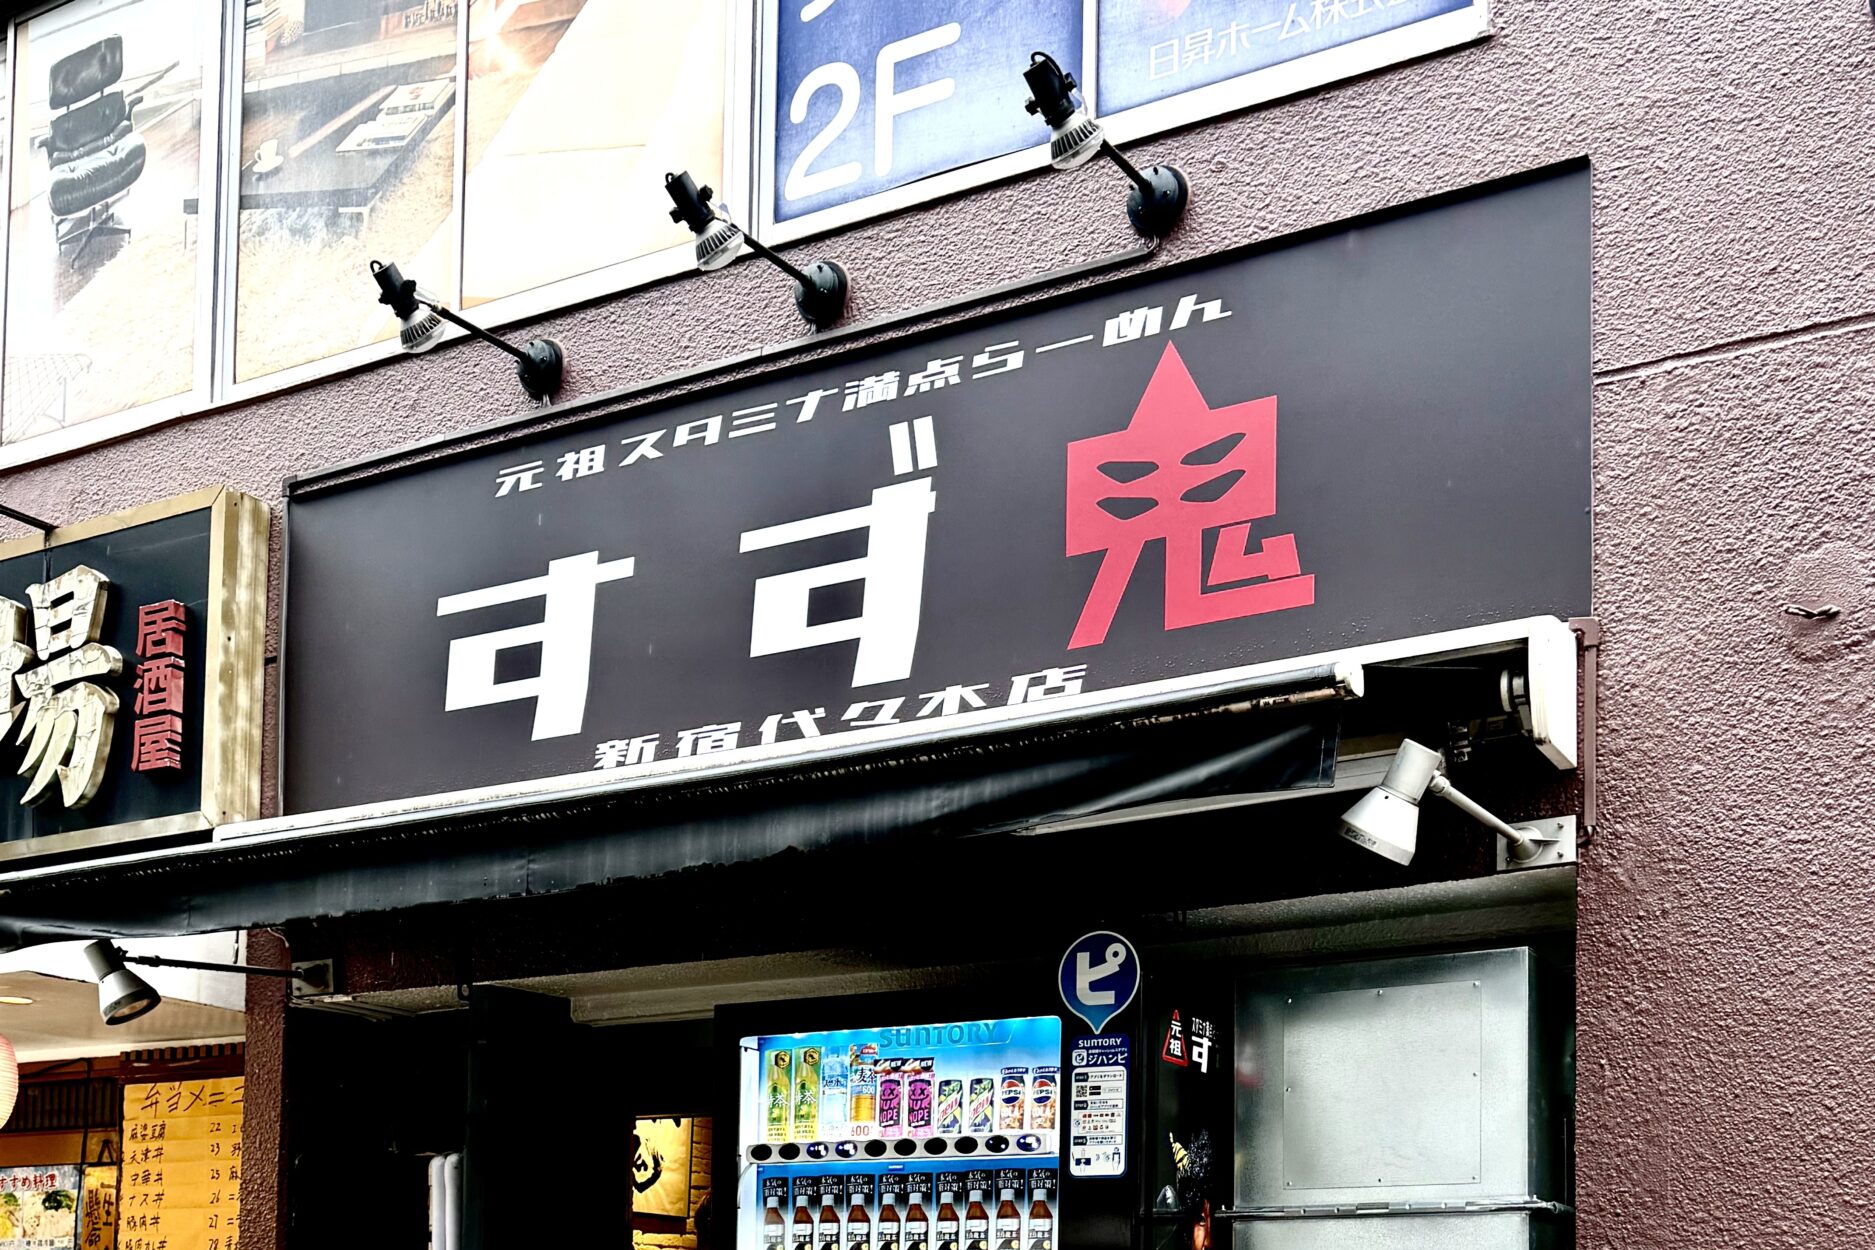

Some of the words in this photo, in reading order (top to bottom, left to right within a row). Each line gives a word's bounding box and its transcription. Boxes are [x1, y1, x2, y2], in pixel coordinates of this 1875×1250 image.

[783, 22, 961, 201] 2F
[131, 599, 186, 772] 居酒屋
[593, 664, 1088, 771] 新宿代々木店
[1077, 943, 1126, 1006] ピ
[1078, 1037, 1122, 1048] SUNTORY
[1170, 1021, 1182, 1056] 元祖
